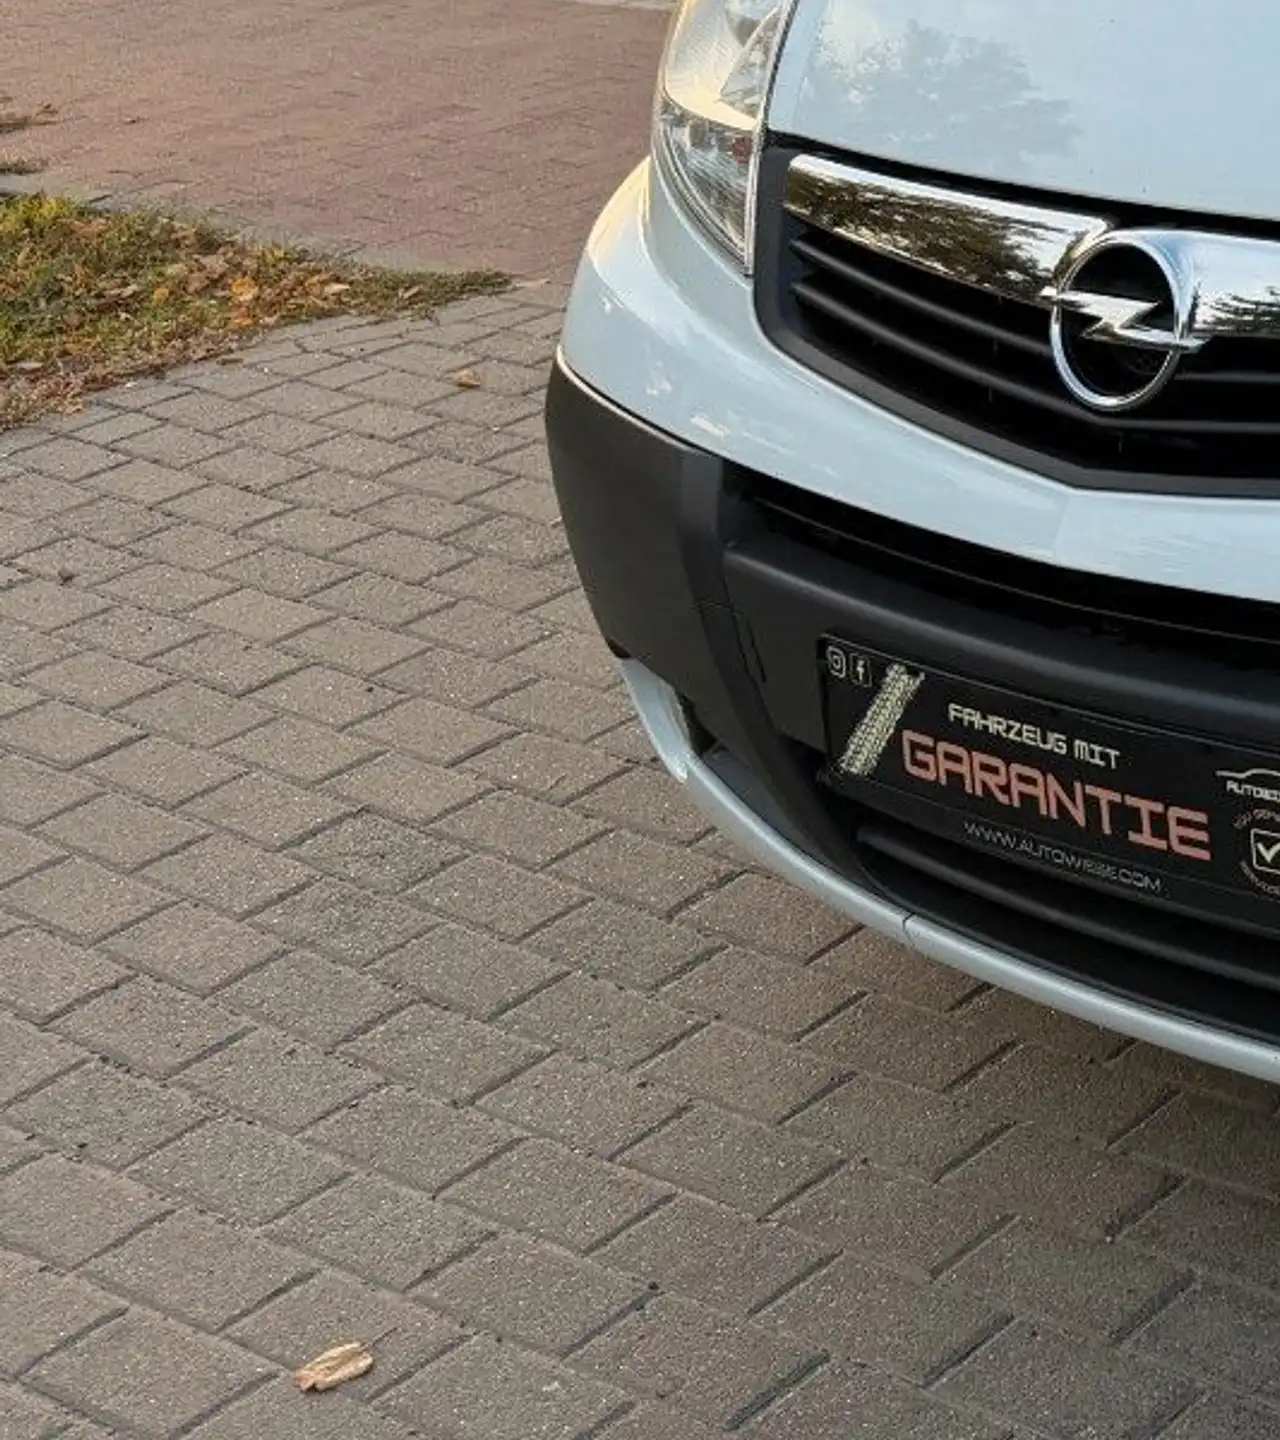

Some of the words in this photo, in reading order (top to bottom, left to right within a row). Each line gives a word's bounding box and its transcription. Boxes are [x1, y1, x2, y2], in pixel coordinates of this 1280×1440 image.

[947, 703, 1068, 755] FAHRZEUG
[1073, 738, 1121, 771] MIT
[901, 731, 1211, 860] GARANTIE
